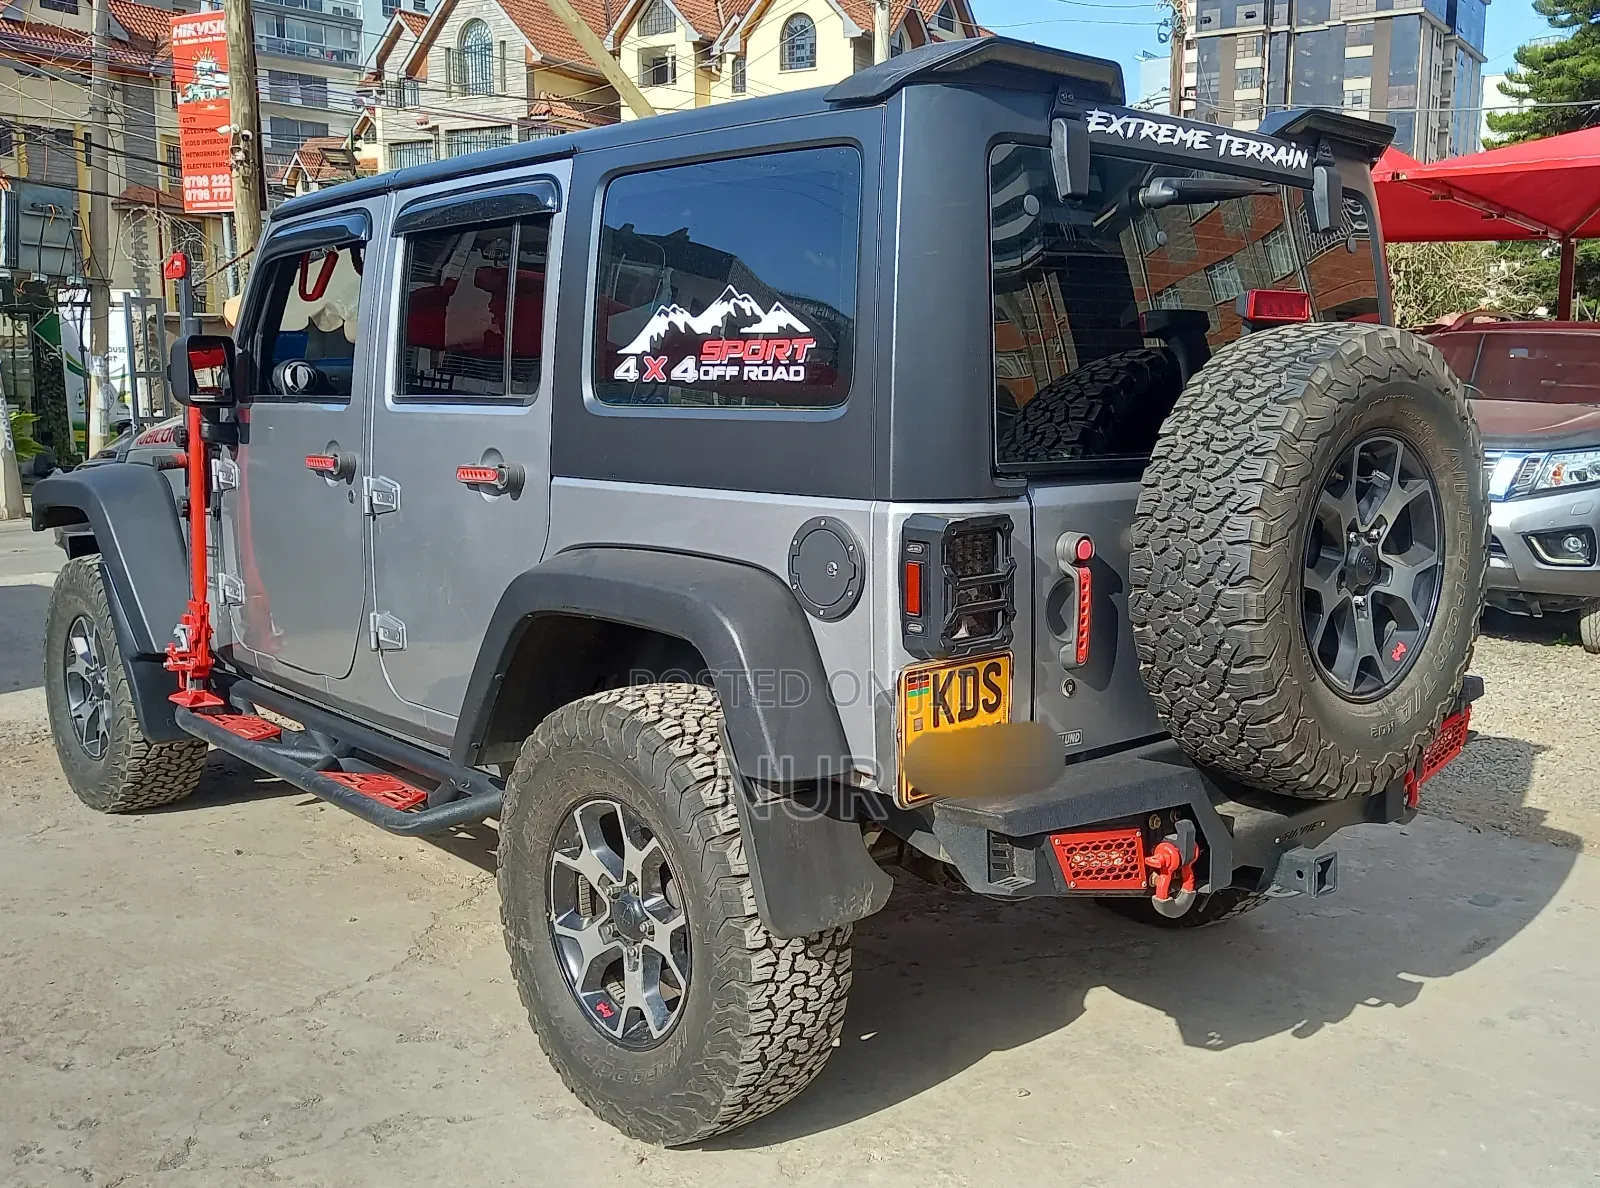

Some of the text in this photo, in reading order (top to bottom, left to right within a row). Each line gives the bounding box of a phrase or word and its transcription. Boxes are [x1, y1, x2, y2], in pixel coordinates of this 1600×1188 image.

[182, 116, 196, 124] CCTV
[1085, 108, 1213, 150] EXTREME
[184, 139, 201, 147] VIDEO
[185, 150, 220, 158] NETWORKING
[186, 162, 211, 170] ELECTRIC
[211, 174, 231, 187] 222
[211, 187, 232, 201] 777
[700, 338, 817, 365] SPORT
[699, 365, 739, 382] OFF
[743, 365, 806, 382] ROAD
[932, 661, 1003, 728] KDS
